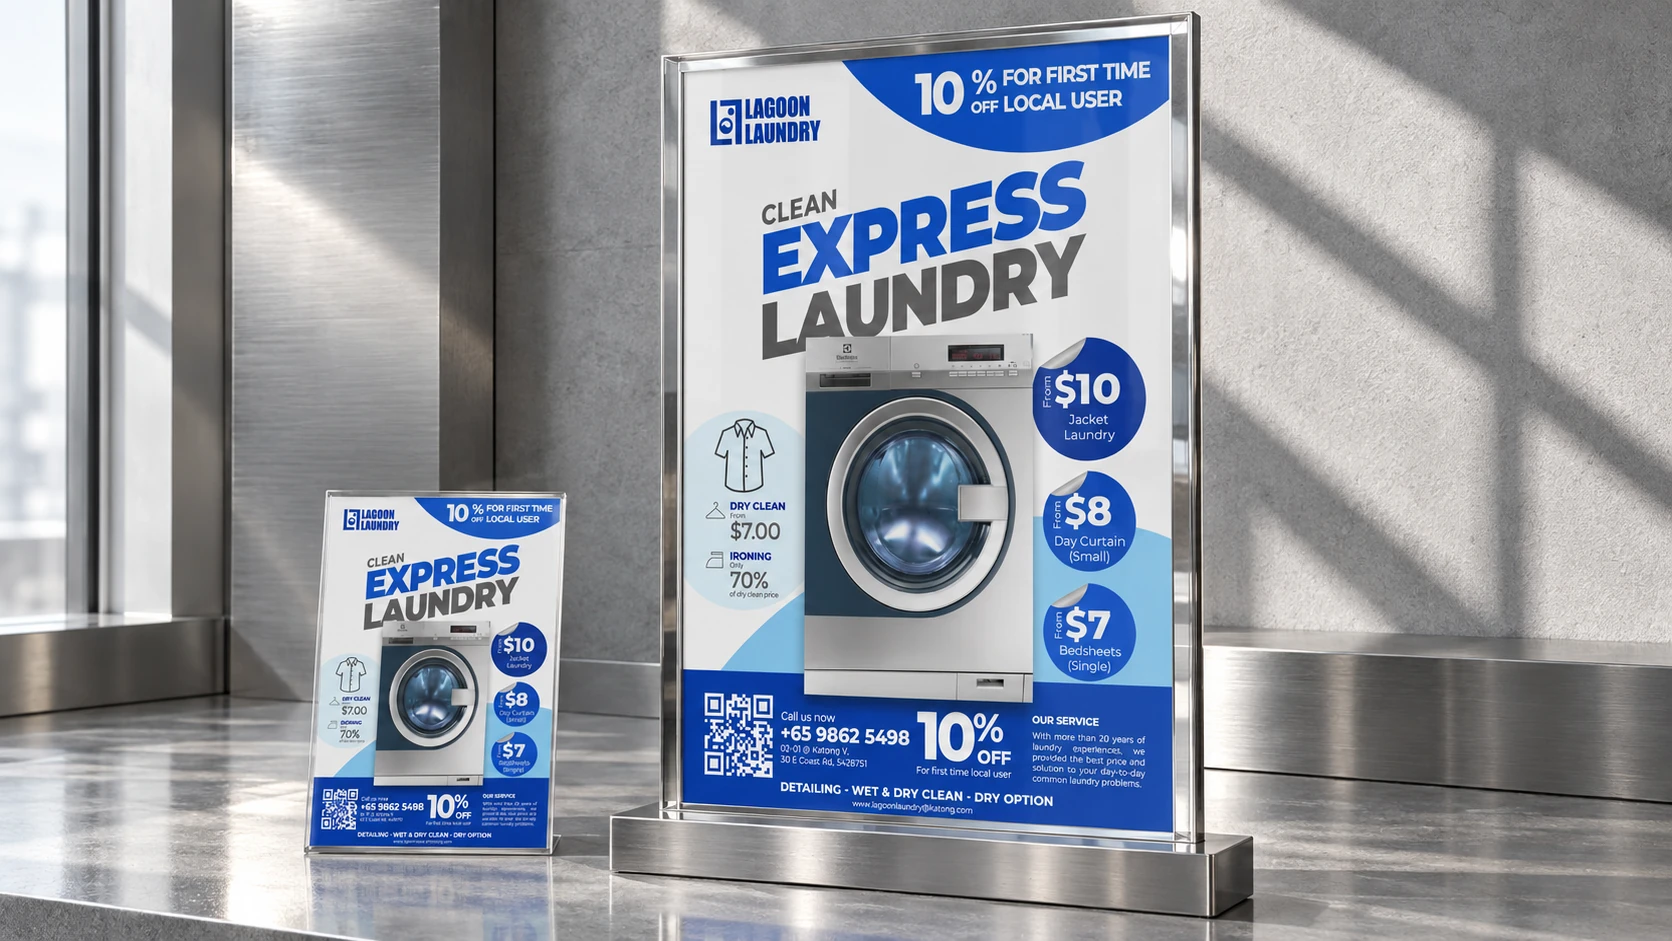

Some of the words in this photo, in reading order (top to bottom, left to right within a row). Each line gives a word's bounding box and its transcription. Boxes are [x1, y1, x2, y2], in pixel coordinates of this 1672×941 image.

[971, 69, 997, 94] %
[1003, 68, 1041, 86] FOR
[1046, 64, 1099, 83] FIRST
[1102, 61, 1151, 80] TIME
[914, 70, 964, 116] 10
[971, 100, 999, 114] OFF
[1003, 93, 1066, 112] LOCAL
[1071, 90, 1122, 109] USER
[745, 95, 810, 119] LAGOON
[745, 120, 821, 144] LAUNDRY
[762, 189, 838, 225] CLEAN
[762, 160, 1087, 295] EXPRESS
[762, 233, 1087, 360] LAUNDRY
[1042, 376, 1052, 408] From
[1054, 370, 1120, 409] $10
[1068, 414, 1108, 425] Jacket
[1064, 430, 1116, 442] Laundry
[362, 509, 395, 519] LAGOON
[446, 504, 469, 522] 10
[472, 504, 484, 514] %
[730, 502, 750, 510] DRY
[752, 502, 786, 511] CLEAN
[1053, 501, 1061, 529] From
[1065, 493, 1112, 530] $8
[361, 521, 400, 530] LAUNDRY
[730, 520, 780, 541] $7.00
[1055, 536, 1077, 549] Day
[1080, 536, 1126, 547] Curtain
[367, 553, 404, 568] CLEAN
[730, 552, 772, 561] IRONING
[1069, 551, 1110, 564] (Small)
[366, 544, 520, 600] EXPRESS
[730, 571, 769, 589] 70%
[364, 576, 520, 630] LAUNDRY
[1066, 606, 1111, 642] $7
[504, 636, 535, 654] $10
[1060, 645, 1122, 657] Bedsheets
[1068, 660, 1111, 674] (Single)
[505, 691, 528, 709] $8
[781, 711, 798, 721] Call
[801, 713, 812, 722] us
[814, 714, 836, 723] now
[1032, 715, 1054, 725] OUR
[1056, 716, 1099, 726] SERVICE
[340, 730, 360, 739] 70%
[781, 725, 811, 741] +65
[816, 727, 860, 744] 9862
[864, 728, 910, 746] 5498
[917, 711, 1004, 762] 10%
[1032, 732, 1051, 741] With
[1078, 734, 1096, 742] than
[1099, 735, 1109, 743] 20
[1112, 736, 1134, 745] years
[1136, 736, 1146, 744] of
[502, 741, 526, 759] $7
[977, 750, 1012, 765] OFF
[1032, 743, 1062, 752] laundry
[1133, 748, 1145, 756] we
[780, 755, 790, 764] 30
[792, 756, 797, 764] E
[799, 757, 820, 766] Coast
[1070, 755, 1083, 763] the
[1106, 757, 1127, 767] price
[1129, 759, 1145, 767] and
[916, 766, 930, 775] For
[931, 766, 948, 776] first
[950, 768, 969, 776] time
[971, 768, 991, 778] local
[993, 770, 1012, 779] user
[1032, 764, 1064, 773] solution
[1079, 767, 1097, 776] your
[1032, 776, 1068, 784] common
[1070, 776, 1100, 787] laundry
[780, 782, 841, 795] DETAILING
[851, 785, 879, 797] WET
[881, 786, 890, 797] &
[894, 788, 919, 799] DRY
[922, 789, 963, 801] CLEAN
[975, 792, 1000, 804] DRY
[1004, 794, 1053, 806] OPTION
[378, 803, 399, 811] 9862
[427, 794, 469, 819] 10%
